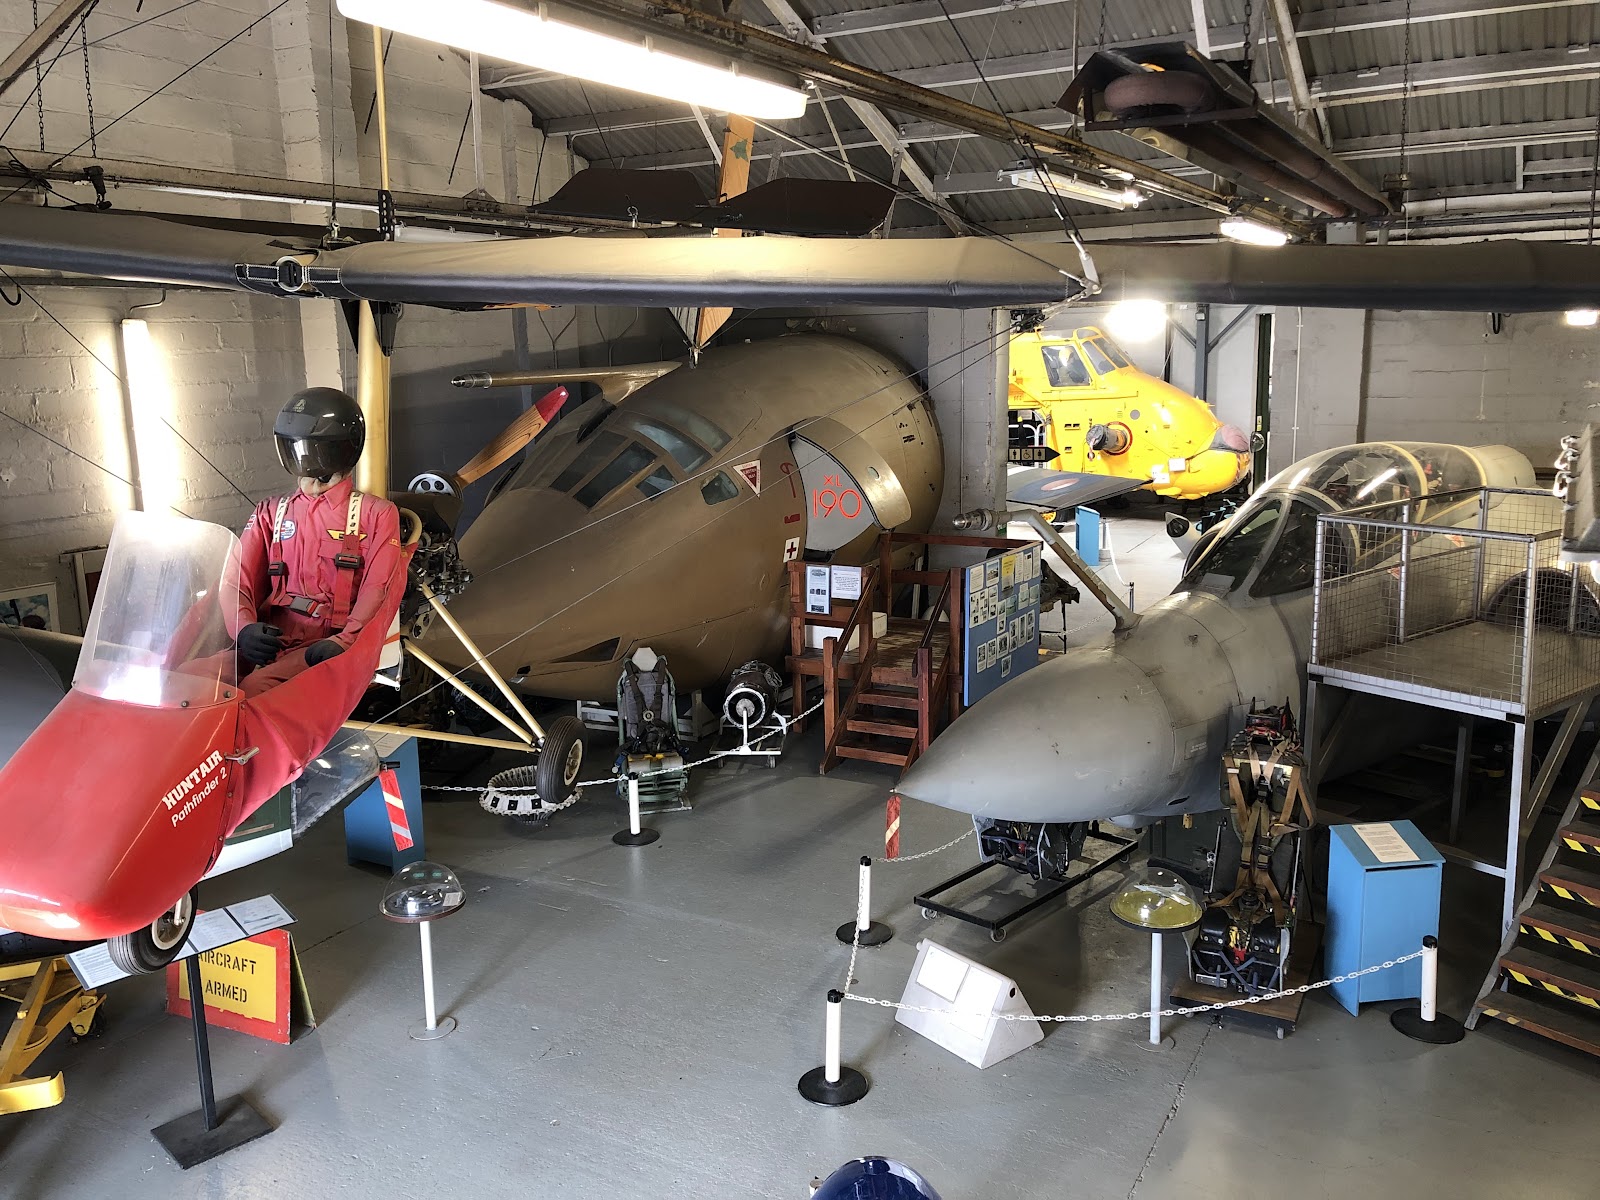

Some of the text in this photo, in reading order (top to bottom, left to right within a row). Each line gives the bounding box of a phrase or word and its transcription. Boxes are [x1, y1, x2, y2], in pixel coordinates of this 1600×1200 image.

[823, 475, 843, 487] XL
[813, 489, 862, 519] 190
[161, 750, 223, 811] HUNTAIR
[171, 766, 228, 828] Pathfinder 2
[205, 979, 248, 1003] ARMED
